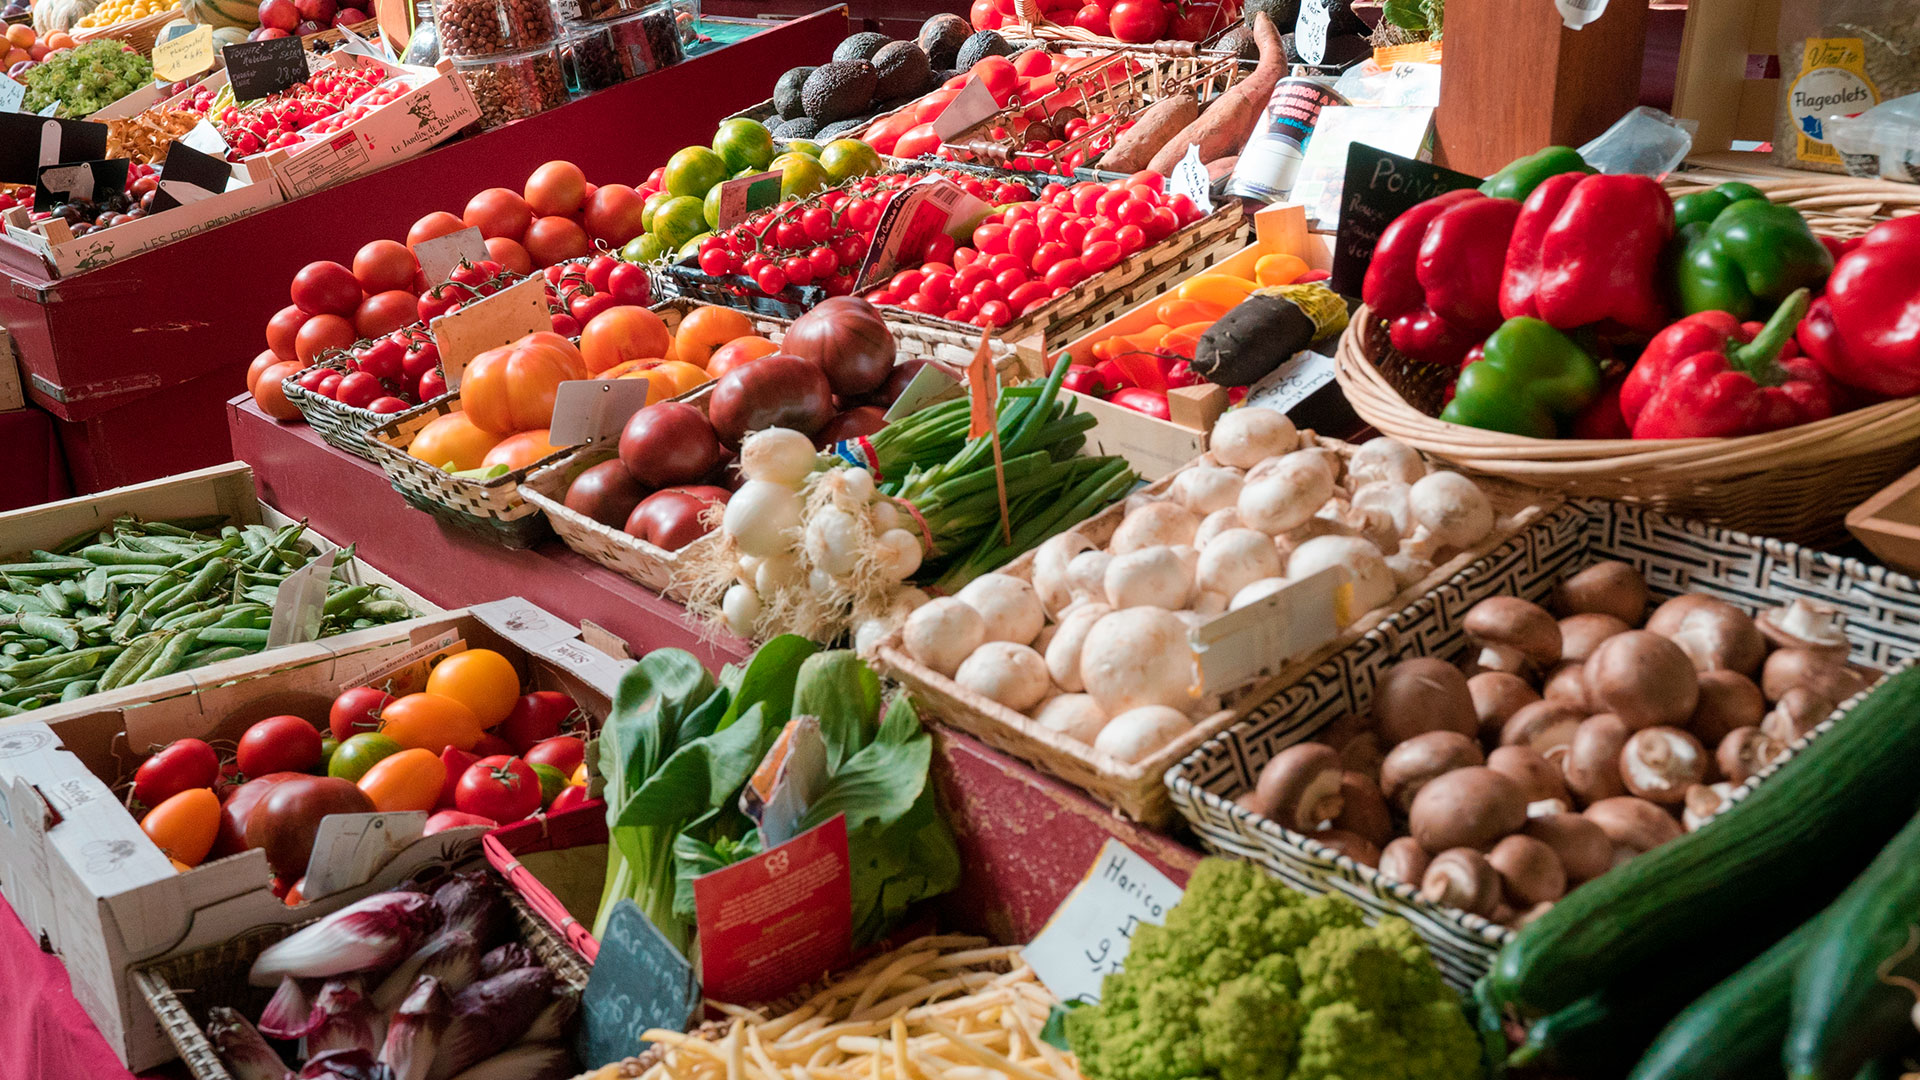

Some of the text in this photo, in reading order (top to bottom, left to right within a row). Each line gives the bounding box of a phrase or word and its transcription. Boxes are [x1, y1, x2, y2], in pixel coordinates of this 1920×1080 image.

[1794, 86, 1867, 111] Flageolets
[403, 130, 428, 147] Jardin
[427, 123, 437, 133] de
[438, 107, 469, 127] Rabelais
[307, 165, 324, 175] FRANCE
[876, 234, 886, 249] La
[386, 642, 434, 669] Gourmande
